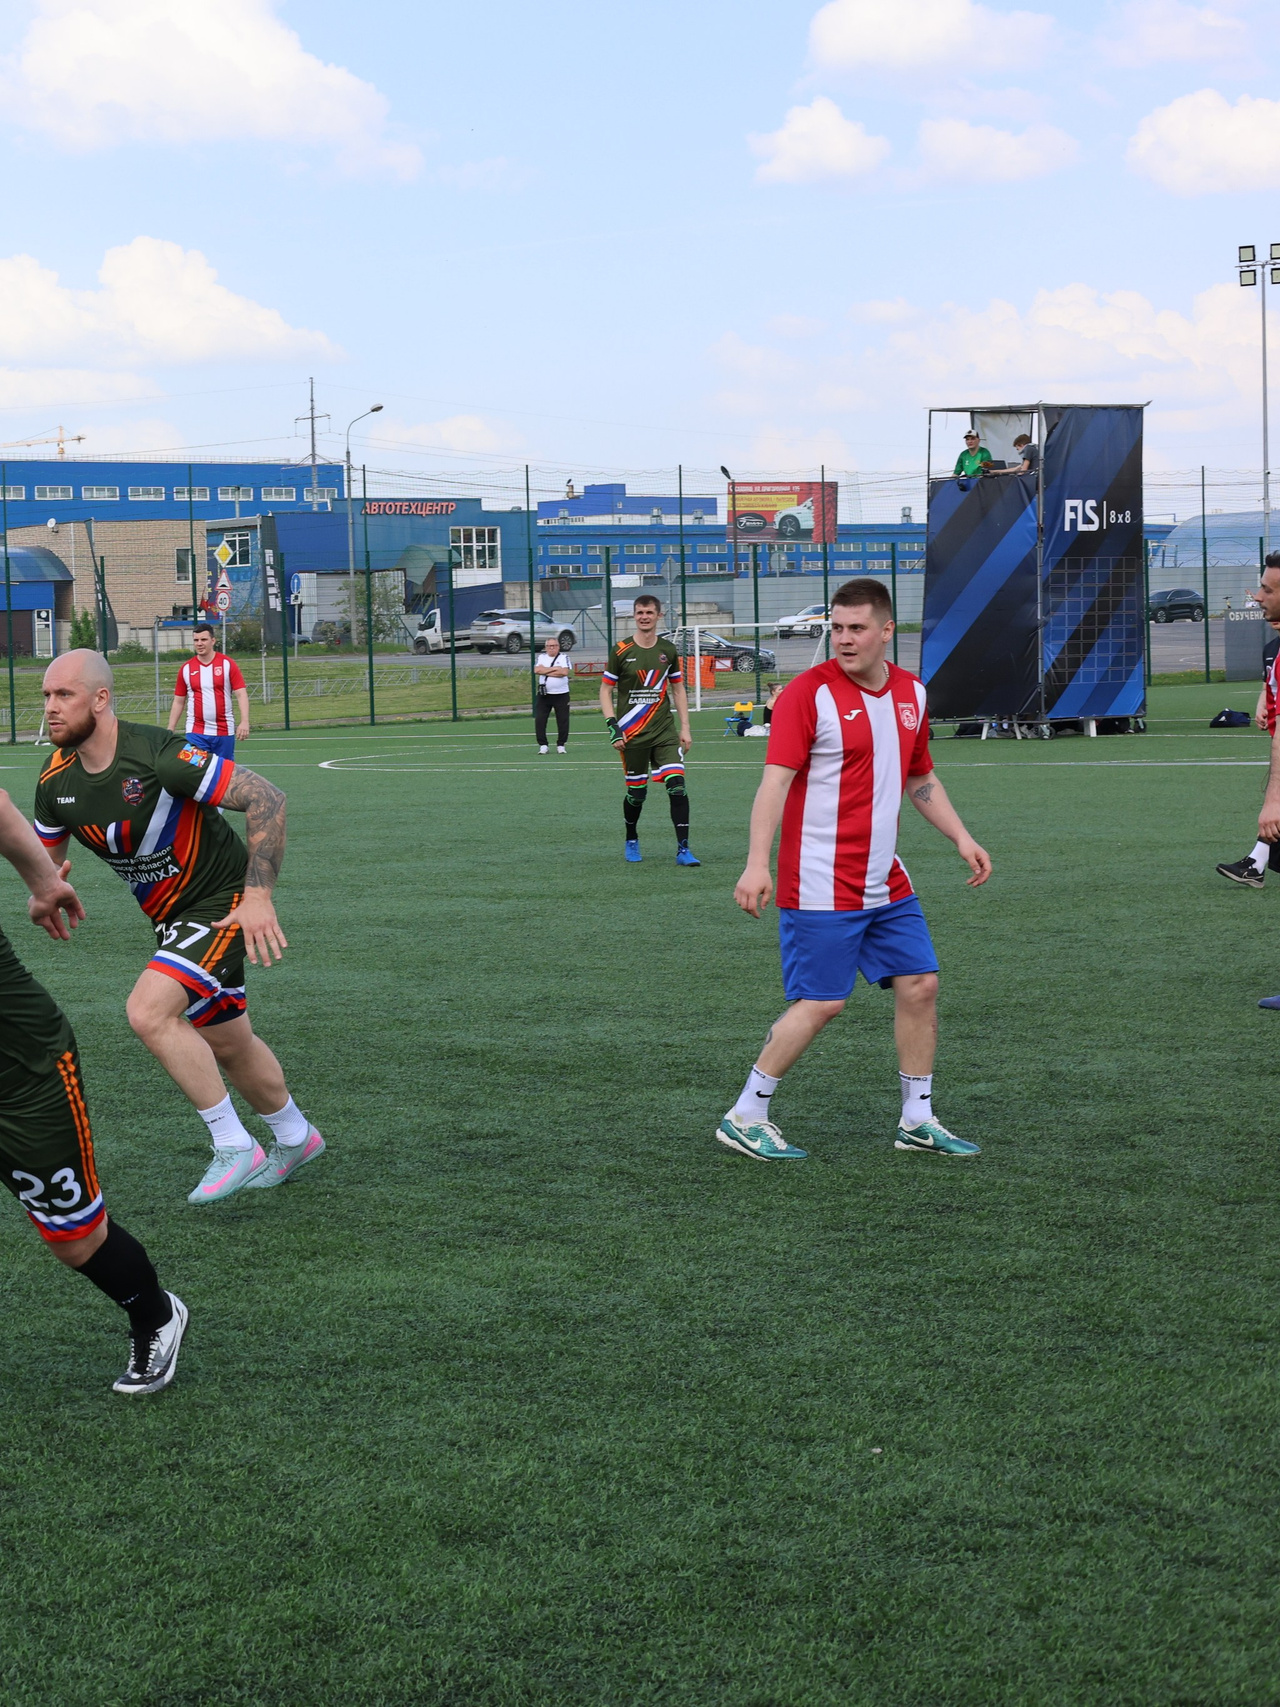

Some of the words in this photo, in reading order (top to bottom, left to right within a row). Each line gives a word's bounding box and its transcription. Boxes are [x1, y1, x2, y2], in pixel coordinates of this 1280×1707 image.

[361, 502, 456, 517] АВТОТЕХЦЕНТР
[1064, 499, 1100, 532] FLS
[1109, 510, 1131, 523] 8x8
[219, 597, 228, 606] 40
[1229, 611, 1266, 621] ОБУЧЕНИ
[56, 796, 76, 804] TEAM
[137, 855, 173, 871] области
[12, 1167, 82, 1209] 23
